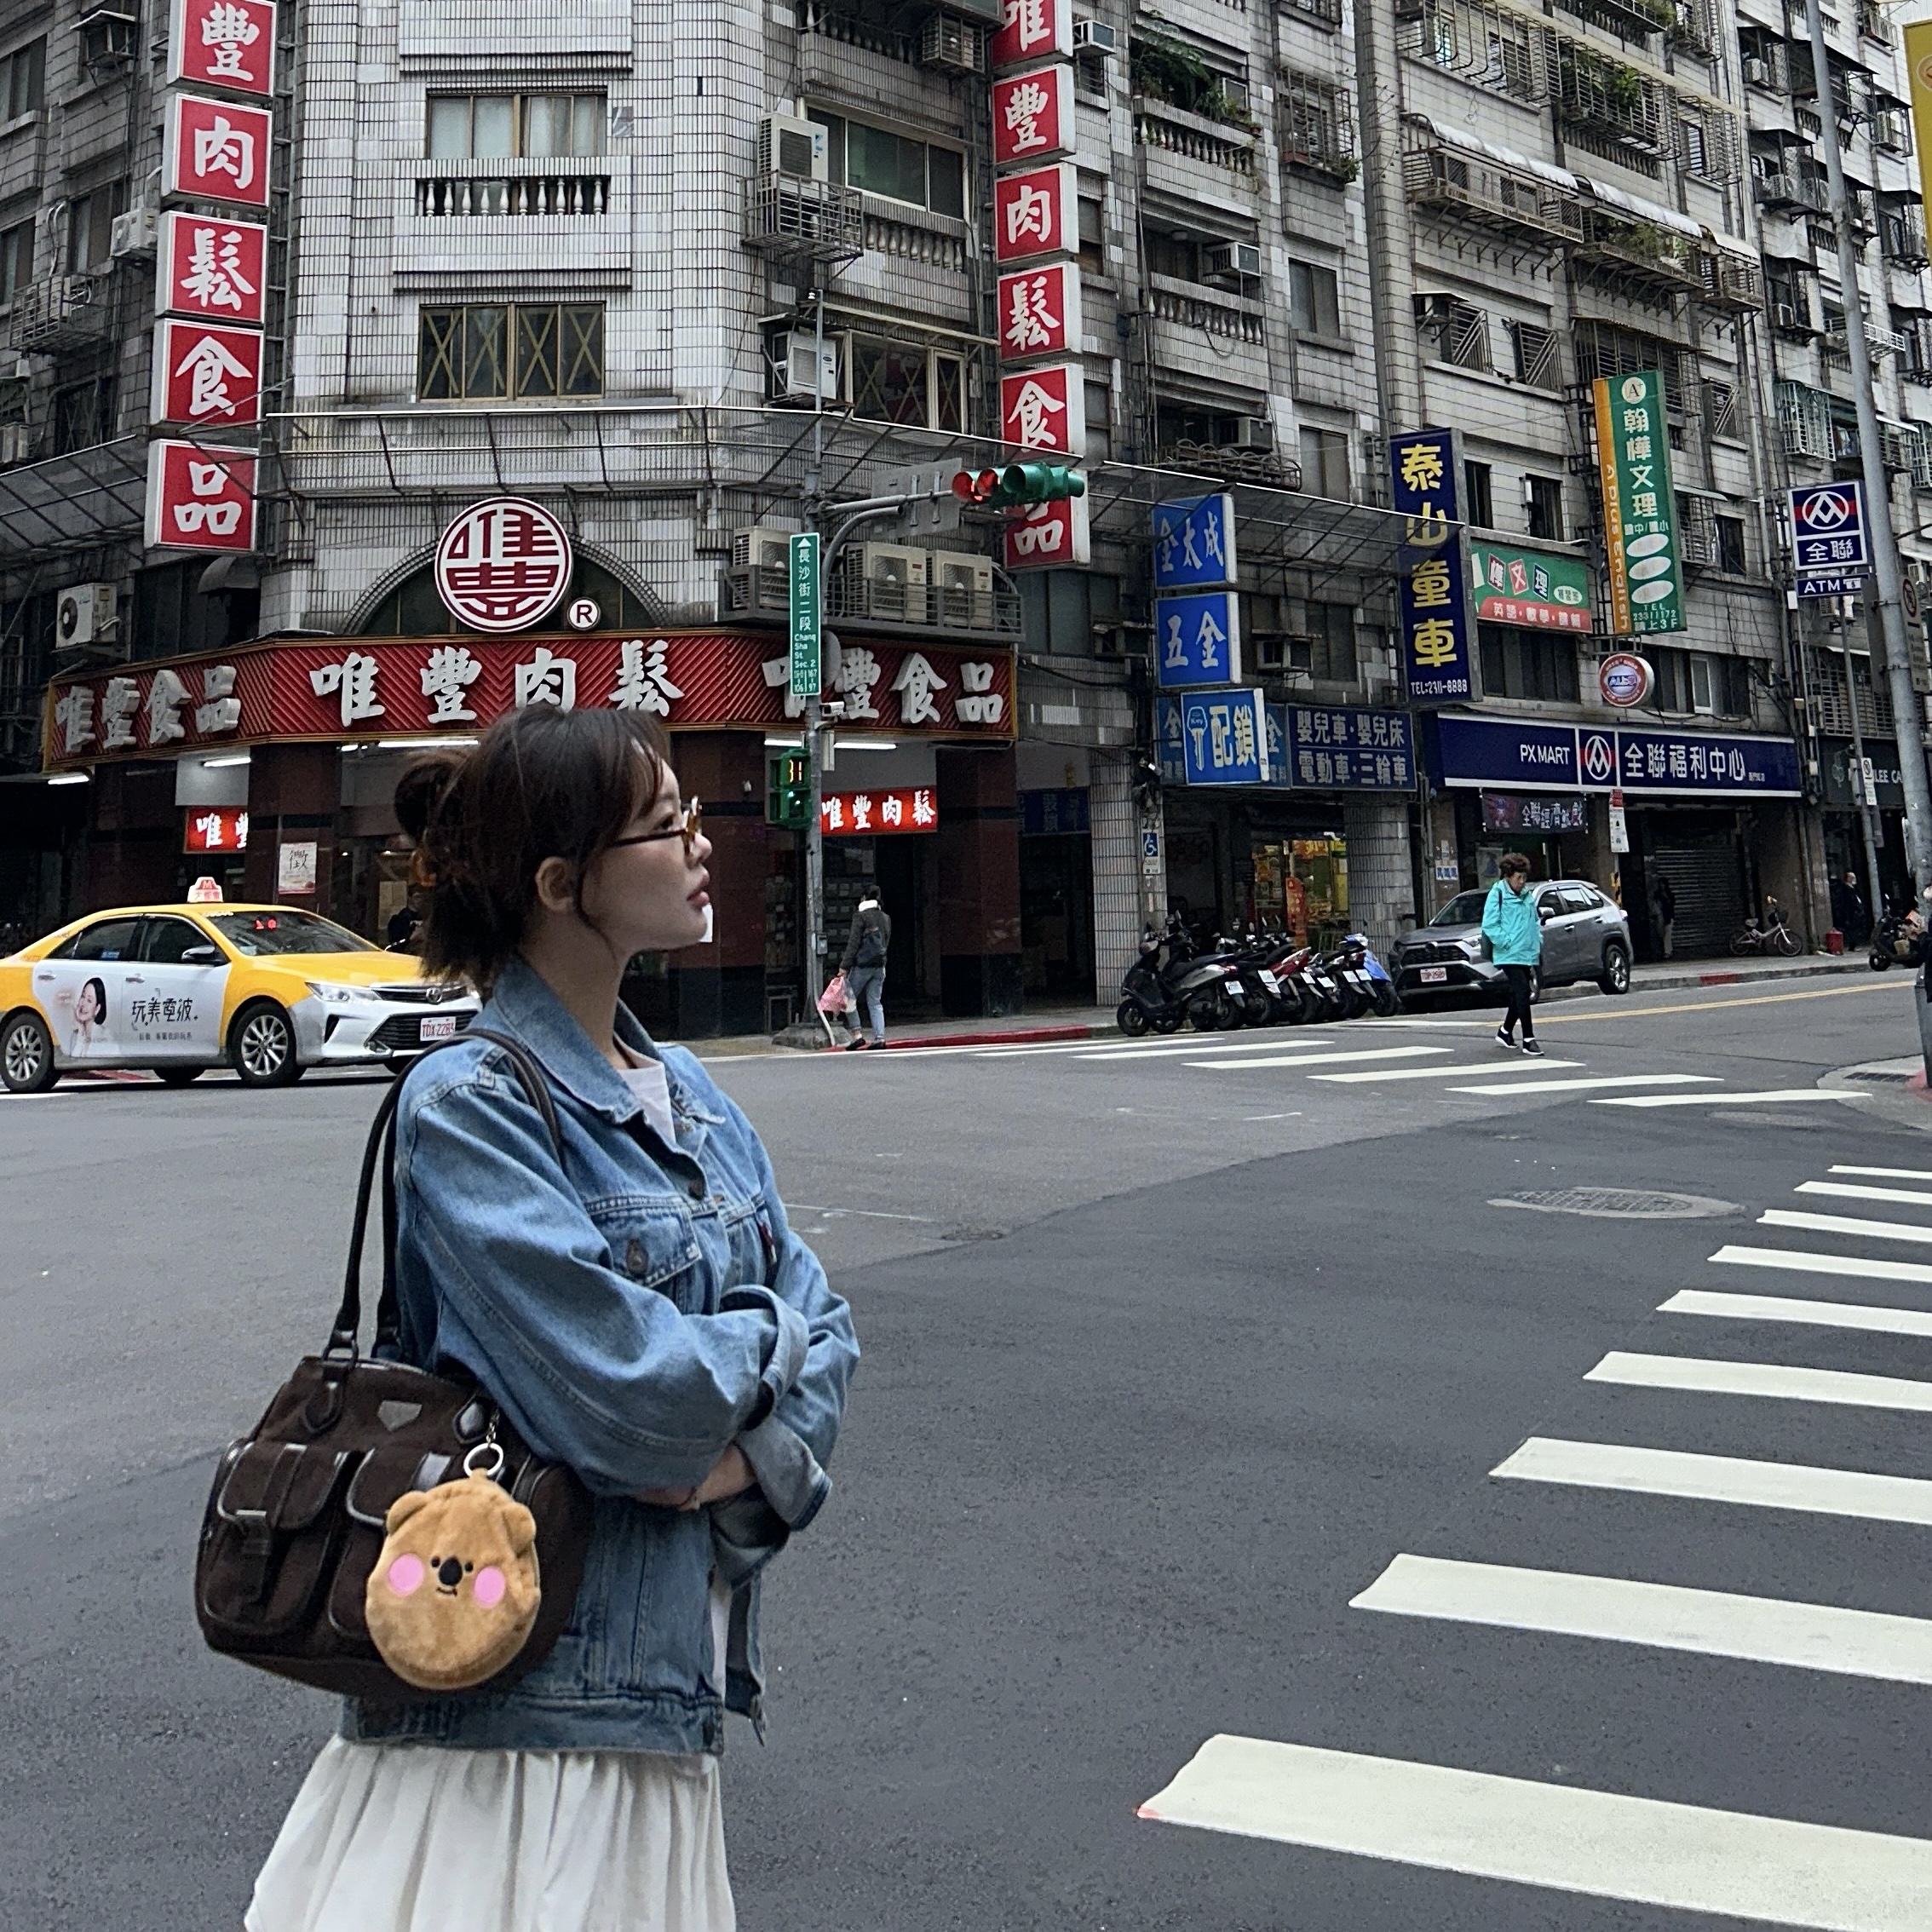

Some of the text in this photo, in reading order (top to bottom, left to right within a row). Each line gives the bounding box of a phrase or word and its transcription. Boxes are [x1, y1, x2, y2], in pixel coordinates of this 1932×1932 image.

[174, 2, 260, 536] 豐肉鬆食品
[1157, 510, 1224, 572] 金太成
[1400, 443, 1458, 667] 泰山童車
[1805, 538, 1854, 562] 全聯
[798, 548, 812, 631] 長沙街二段
[1804, 579, 1841, 594] ATM
[794, 633, 817, 643] Chang
[794, 642, 808, 651] Sha
[1164, 610, 1227, 668] 五金
[55, 665, 242, 753] 唯豐食品
[309, 639, 685, 727] 唯豐肉鬆
[1209, 704, 1257, 768] 配鎖
[1624, 742, 1746, 782] 全聯福利中心
[821, 789, 936, 831] 唯豐肉鬆
